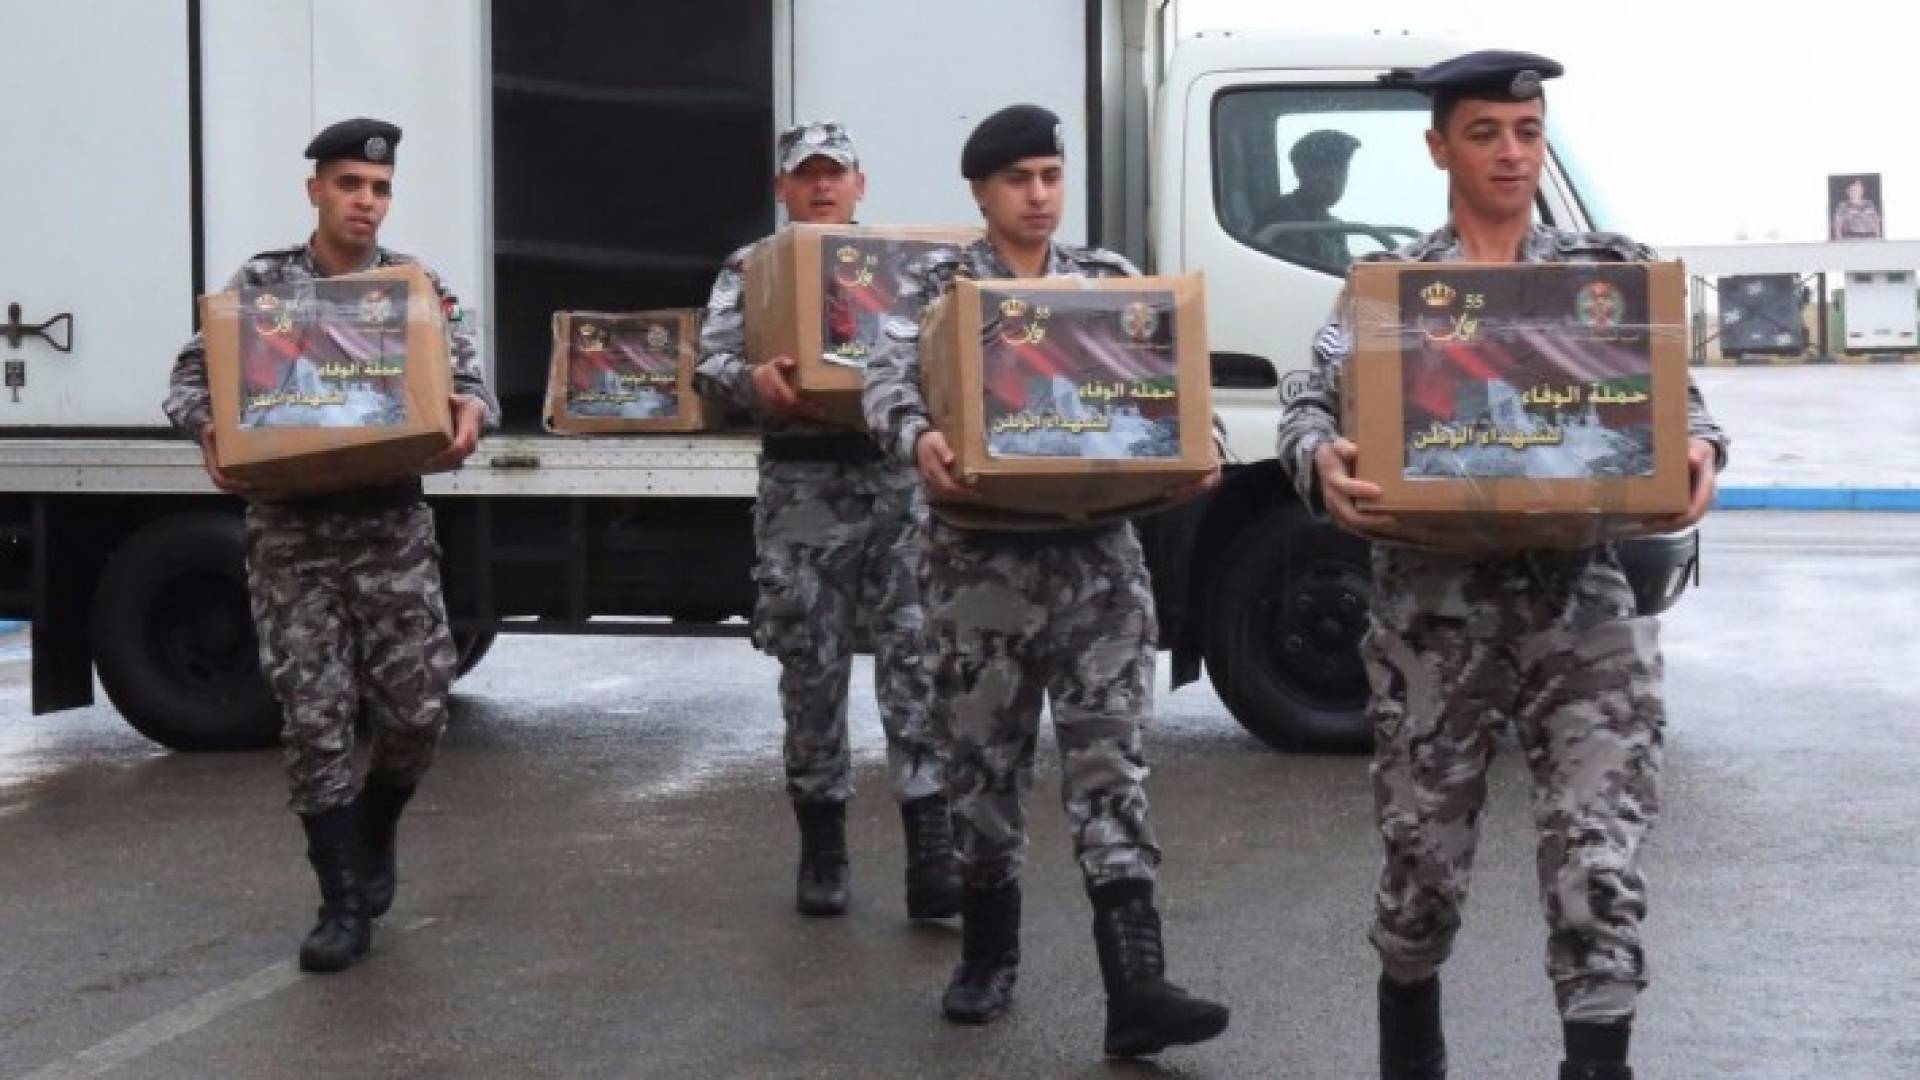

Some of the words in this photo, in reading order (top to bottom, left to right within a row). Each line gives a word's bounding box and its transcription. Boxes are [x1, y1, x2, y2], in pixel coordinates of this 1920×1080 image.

[1464, 293, 1485, 309] 55
[1080, 382, 1123, 400] الوفاء
[1523, 384, 1579, 408] الوفاء
[1588, 382, 1647, 404] حملة
[1414, 423, 1473, 449] الوطن
